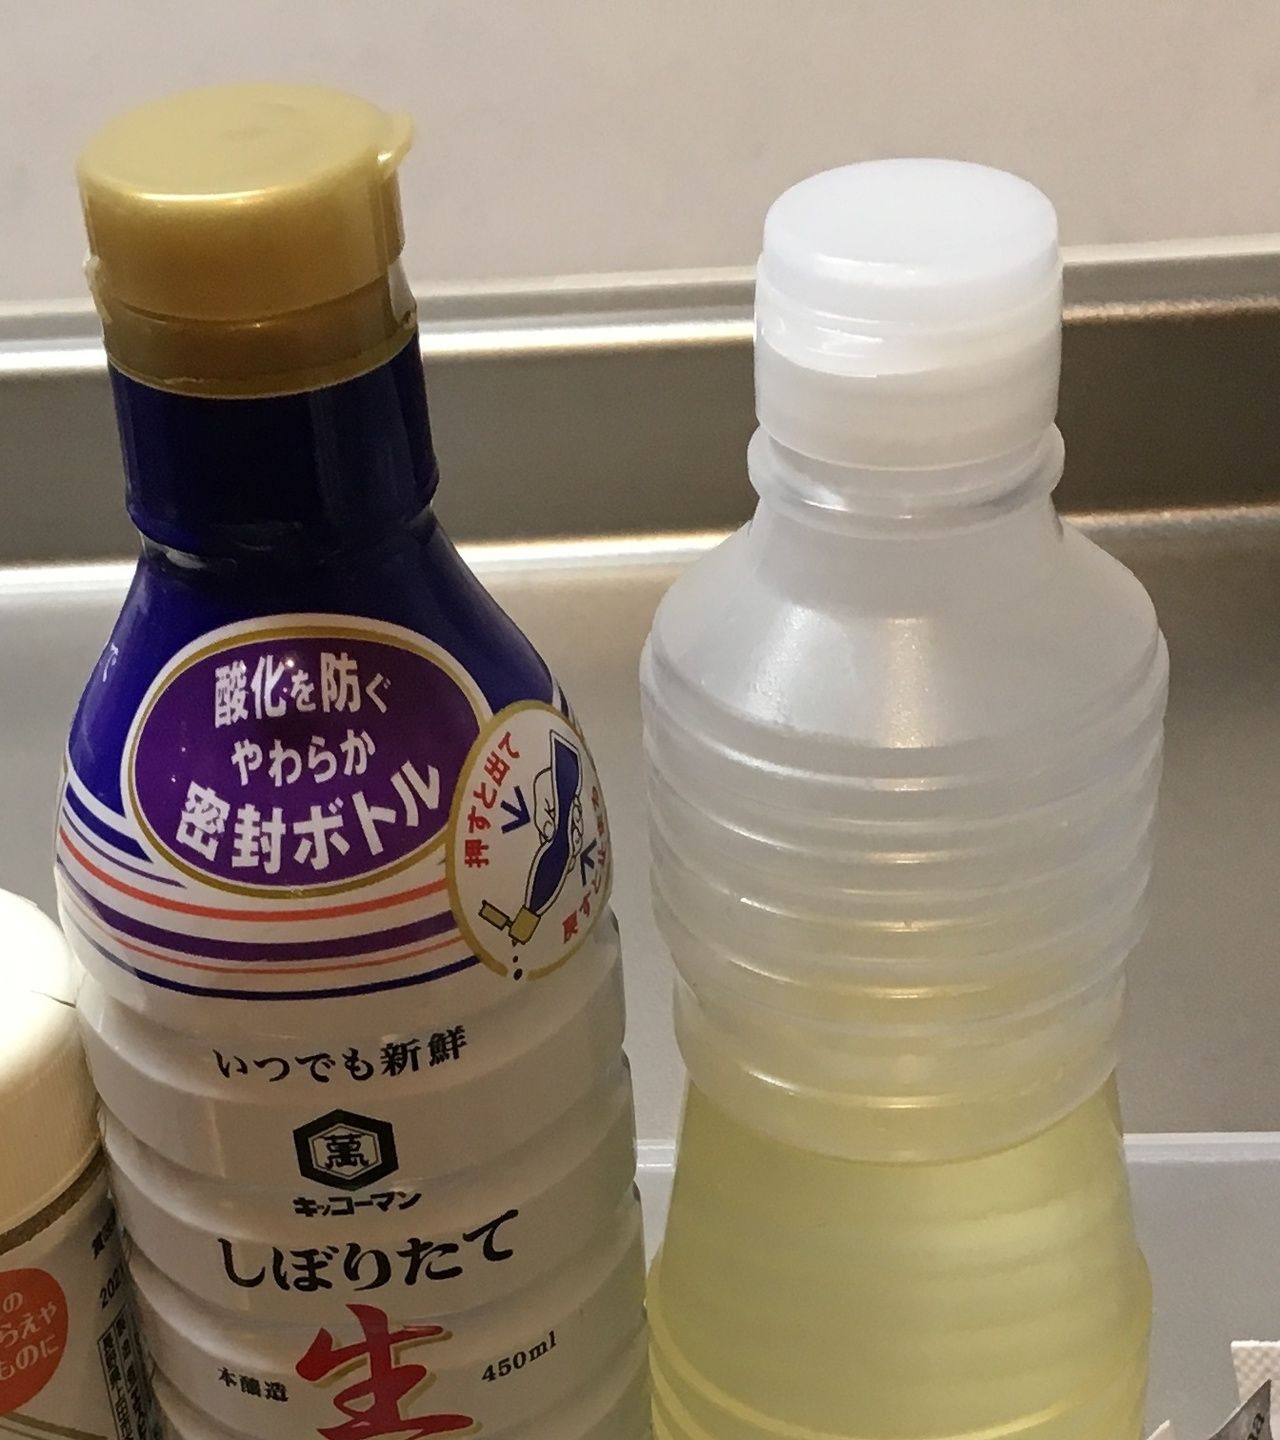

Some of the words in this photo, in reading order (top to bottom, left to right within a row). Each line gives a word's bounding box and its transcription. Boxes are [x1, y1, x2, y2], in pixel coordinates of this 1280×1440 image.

[214, 652, 392, 728] 酸化を防ぐ
[230, 729, 377, 788] やわらか
[176, 760, 442, 875] 密封ボトル
[464, 731, 520, 868] 押すと出て
[213, 1024, 468, 1083] いつでも新鮮
[293, 1191, 422, 1218] キッコーマン
[217, 1208, 520, 1292] しぼりたて
[218, 1366, 289, 1402] 本醸造
[481, 1330, 559, 1385] 450ml
